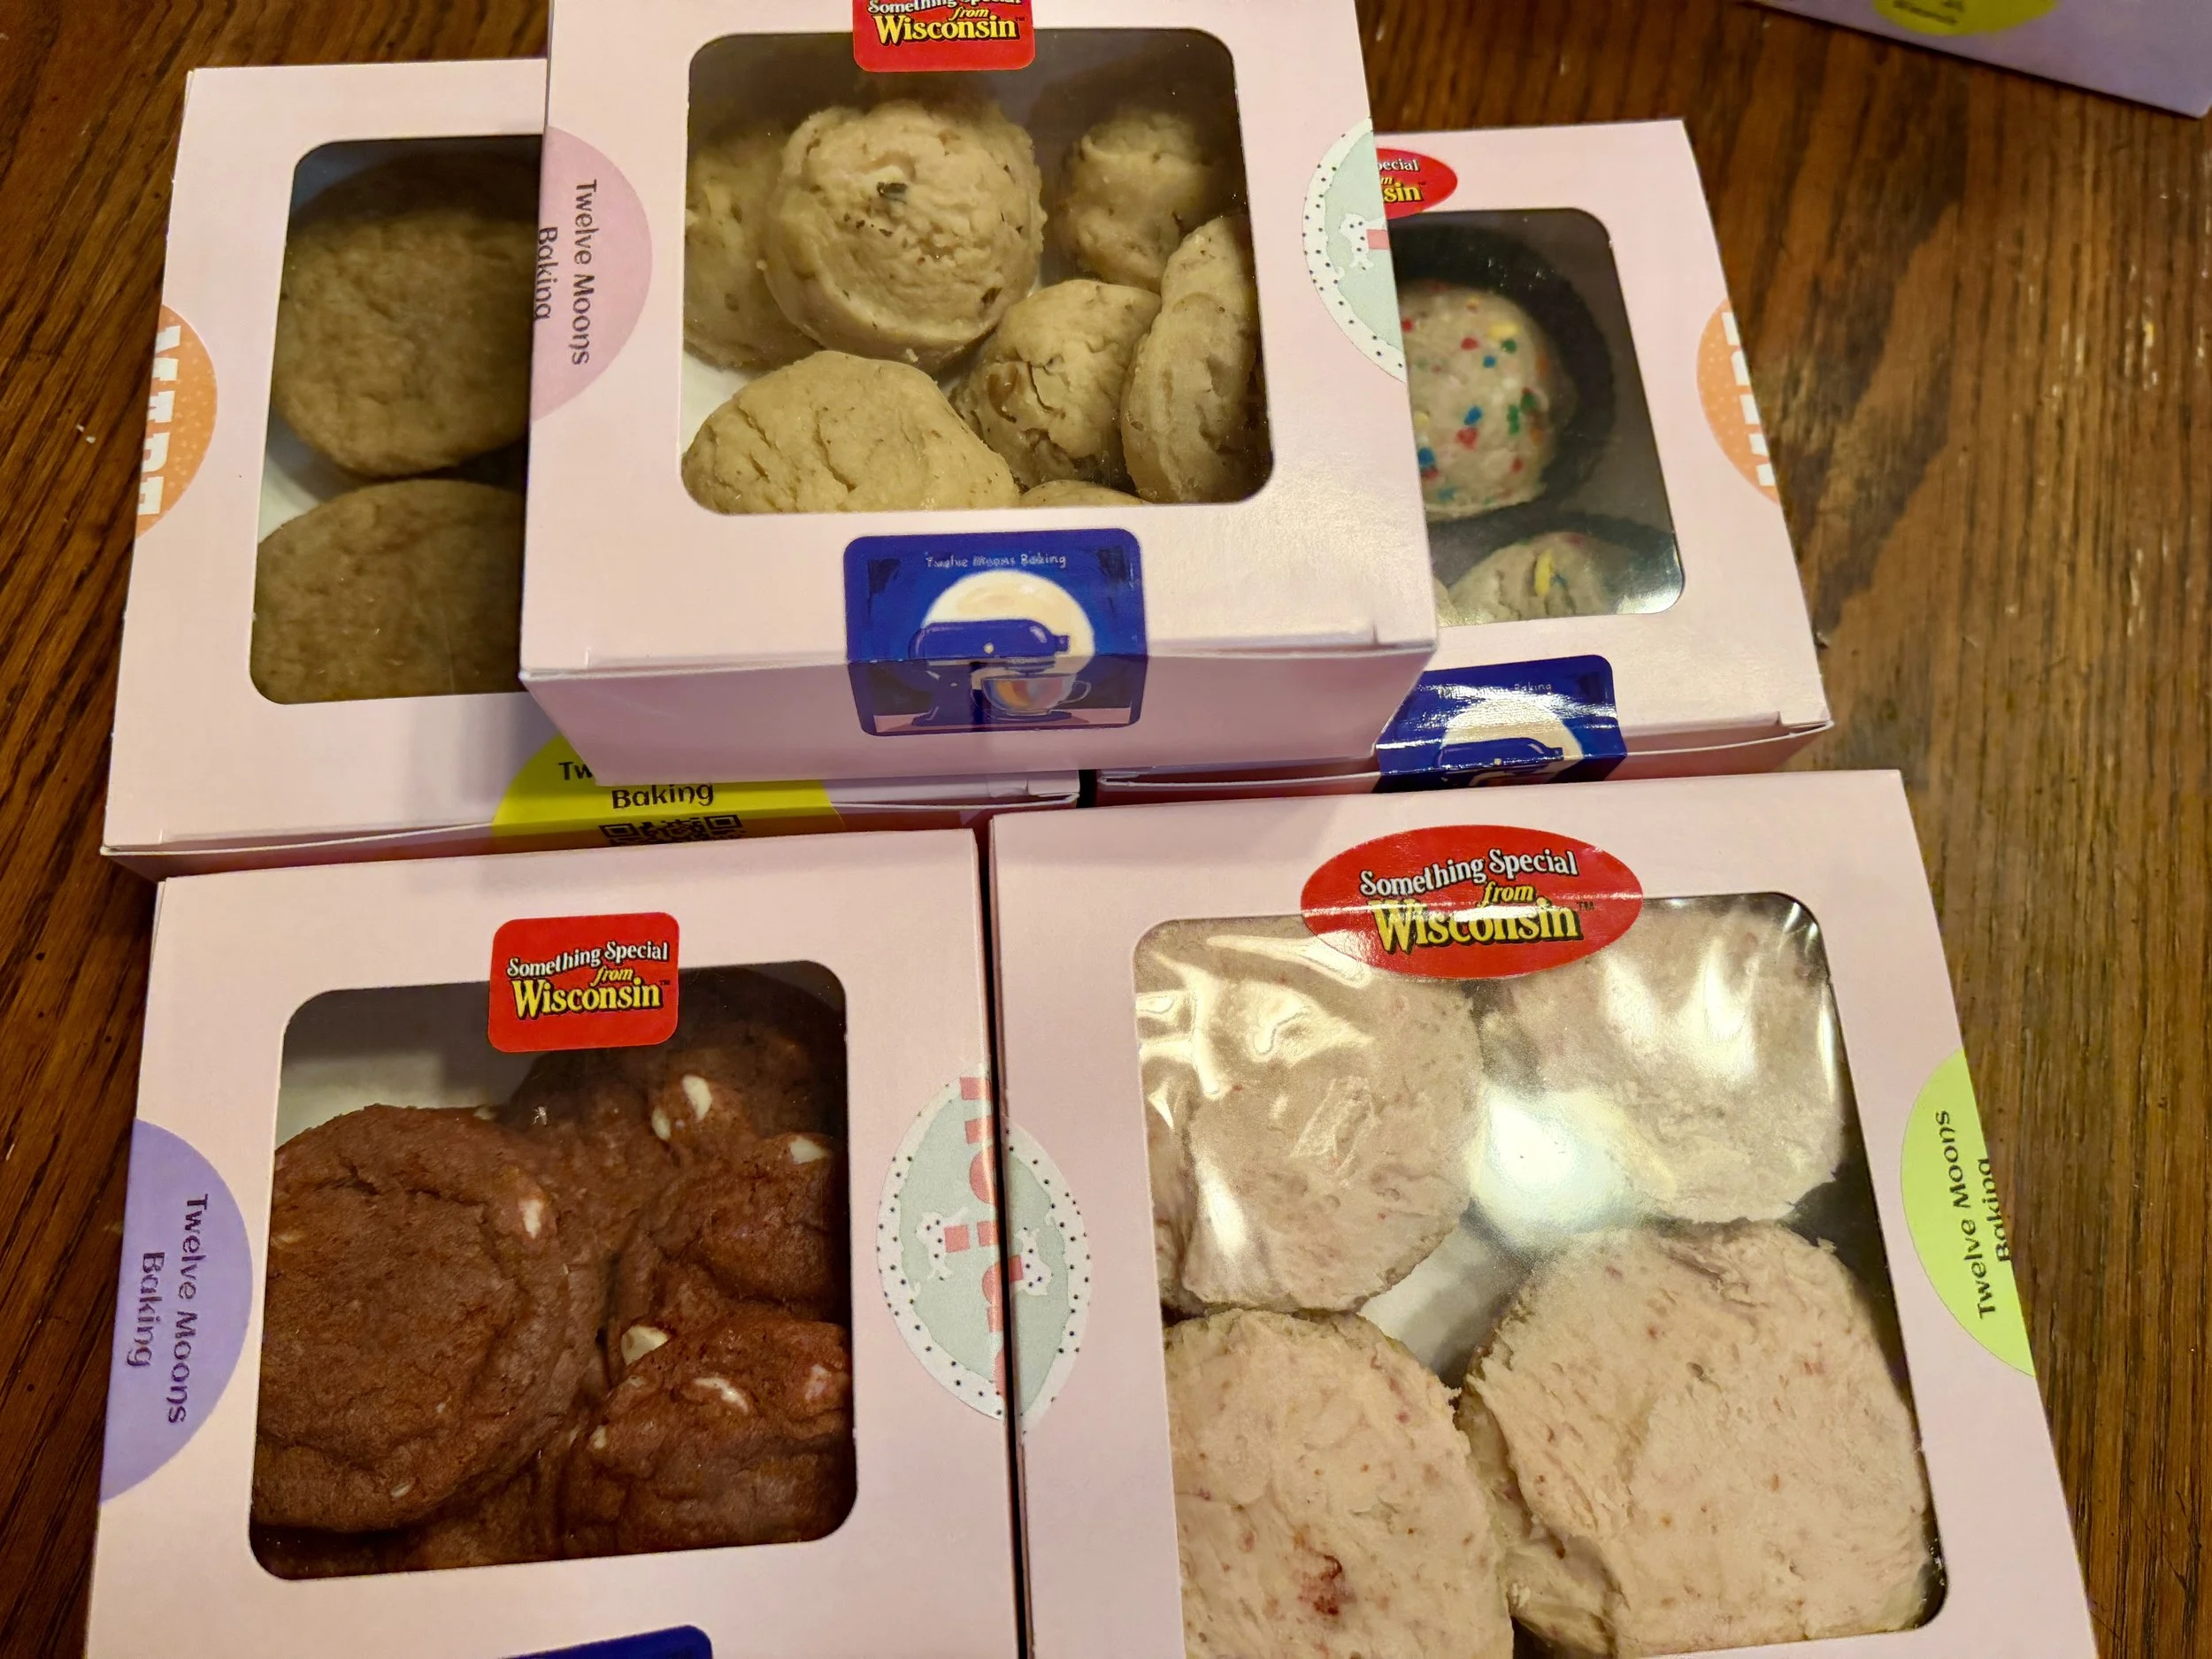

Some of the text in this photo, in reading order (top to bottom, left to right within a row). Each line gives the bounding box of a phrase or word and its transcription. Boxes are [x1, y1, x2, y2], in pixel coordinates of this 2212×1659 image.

[872, 14, 1019, 45] Wisconsin
[949, 6, 990, 21] from
[1377, 157, 1420, 173] pecial
[568, 179, 600, 365] Twelve Moons
[611, 784, 714, 810] Baking
[1359, 848, 1578, 896] Something Special
[1478, 880, 1537, 908] from
[1368, 896, 1583, 955] Wisconsin
[506, 940, 670, 978] Something Special
[589, 965, 635, 987] from
[511, 977, 662, 1019] Wisconsin
[1935, 1110, 1996, 1319] Twelve Moons
[127, 1251, 165, 1368] Baking
[165, 1194, 209, 1425] Twelve Moons
